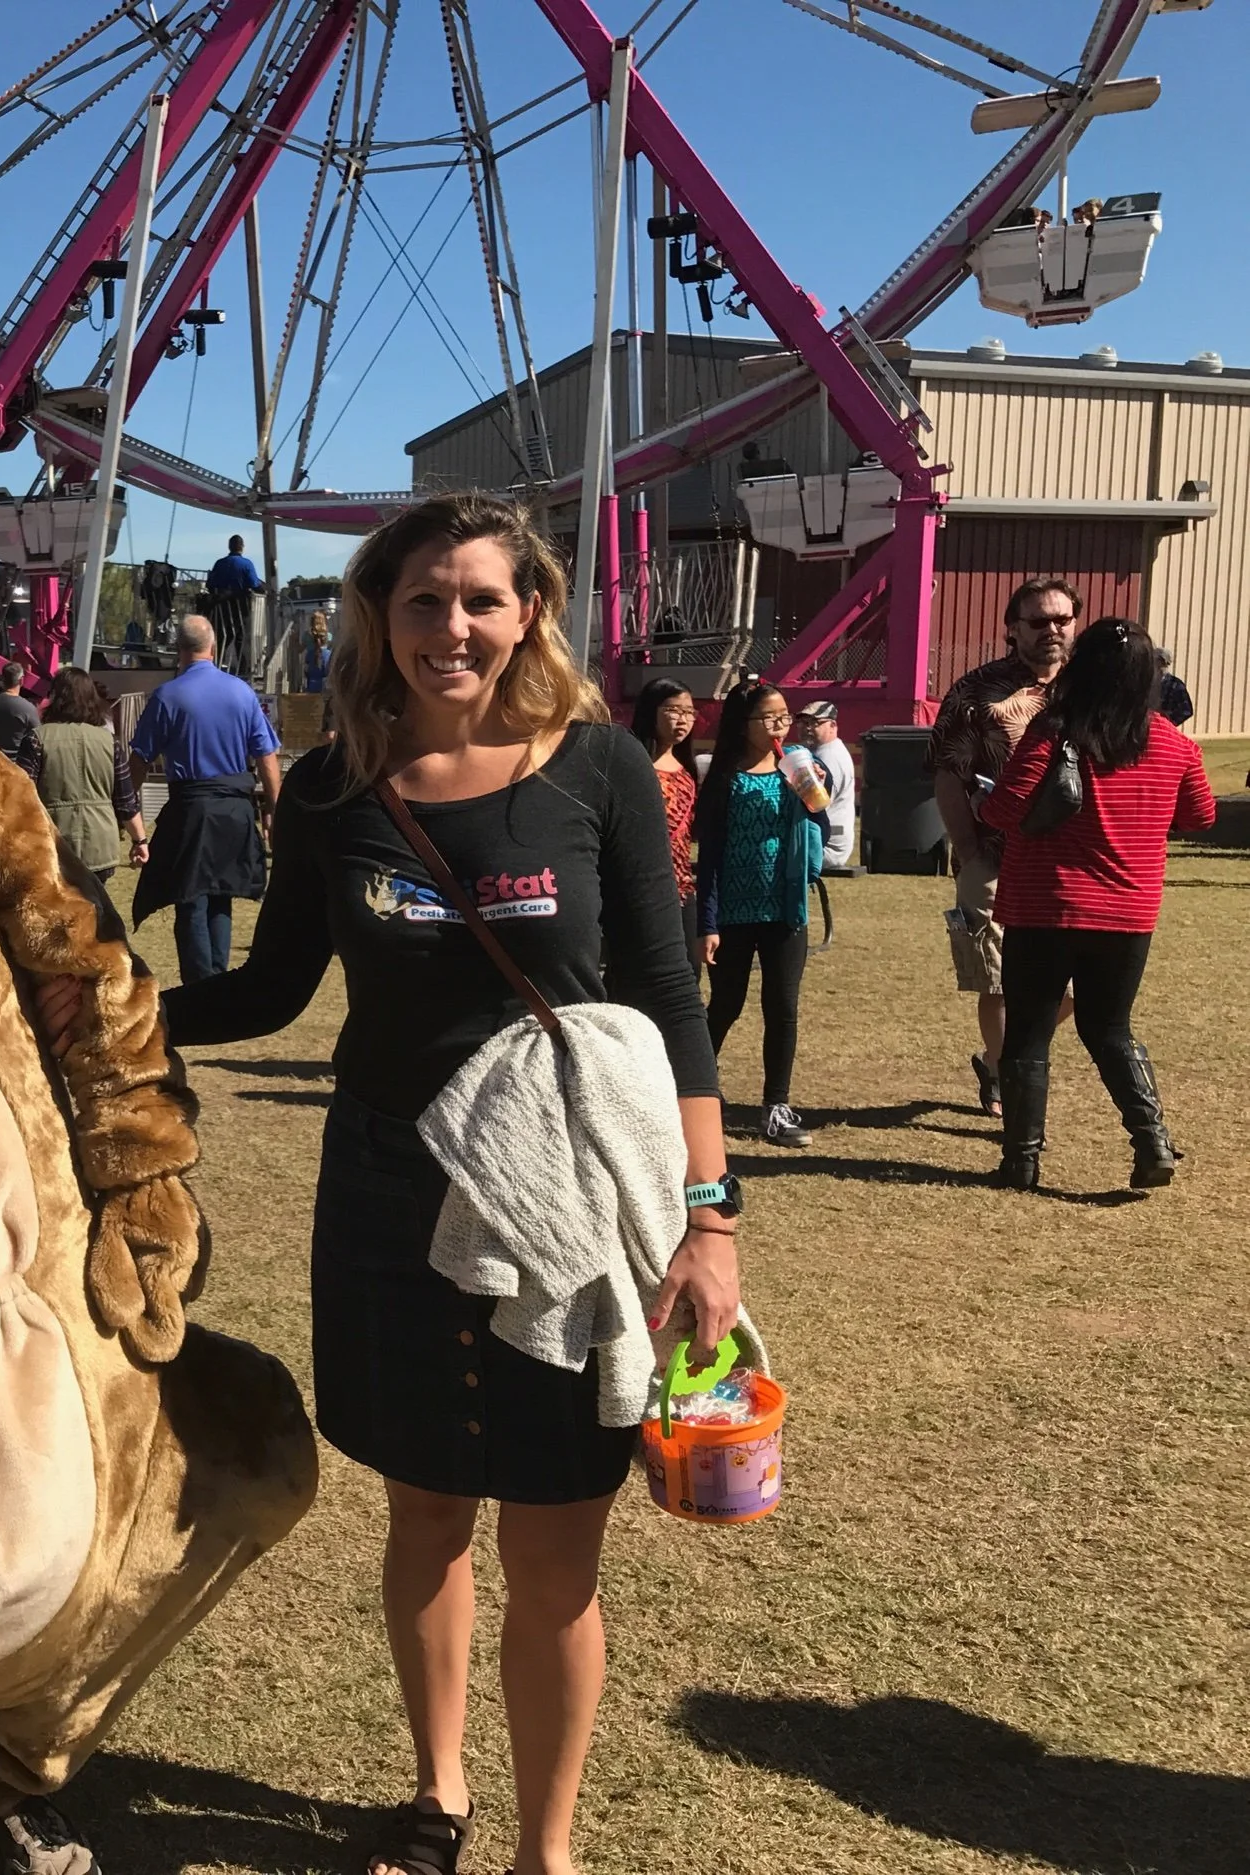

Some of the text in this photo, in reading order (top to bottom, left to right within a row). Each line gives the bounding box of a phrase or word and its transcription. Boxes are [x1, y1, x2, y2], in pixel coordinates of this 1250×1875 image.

[1111, 197, 1135, 213] 4
[862, 451, 883, 466] 3
[63, 482, 84, 496] 15
[520, 901, 551, 913] Care
